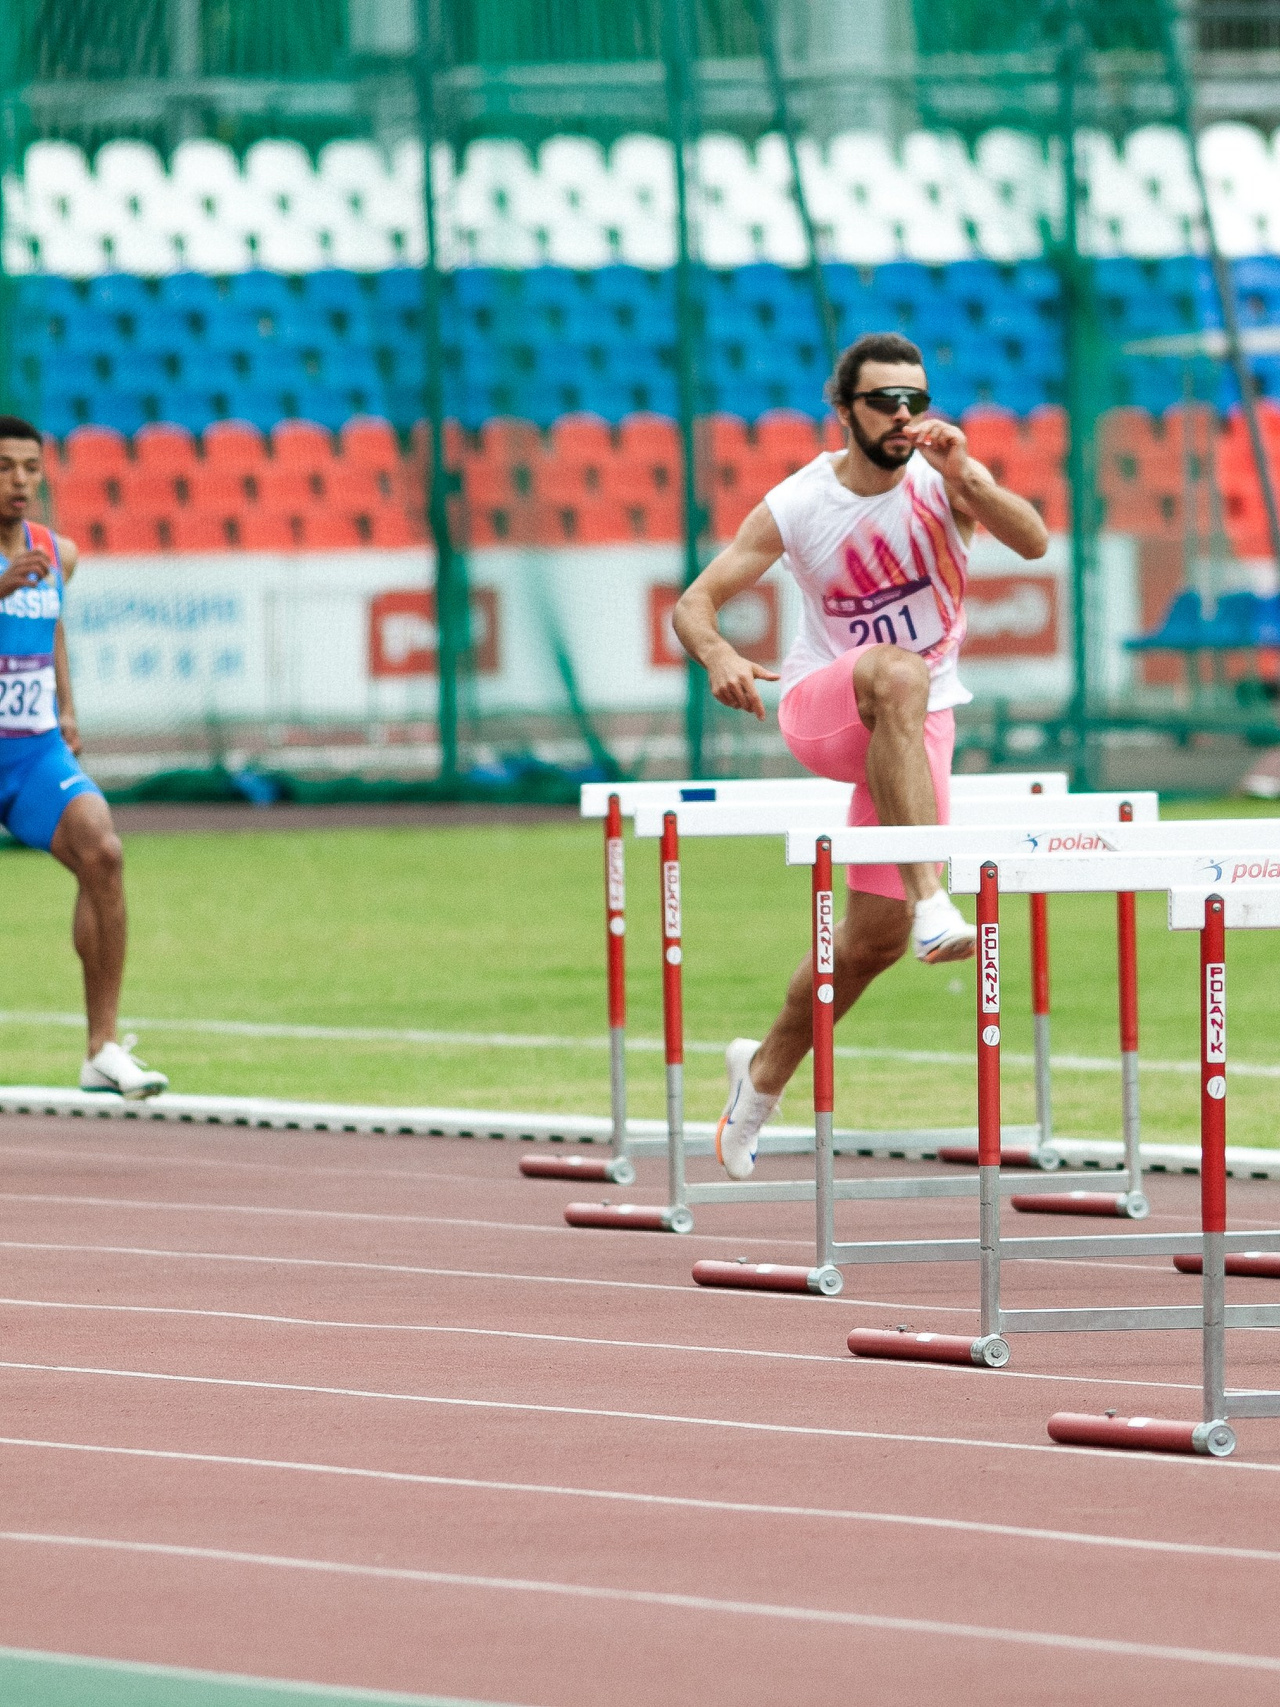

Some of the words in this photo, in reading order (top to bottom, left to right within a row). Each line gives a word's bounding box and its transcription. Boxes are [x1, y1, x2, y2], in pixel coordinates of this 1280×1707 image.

[849, 604, 918, 647] 201
[819, 894, 832, 966] POLANIK
[984, 926, 998, 1005] POLANIK
[1209, 967, 1224, 1054] POLANIK
